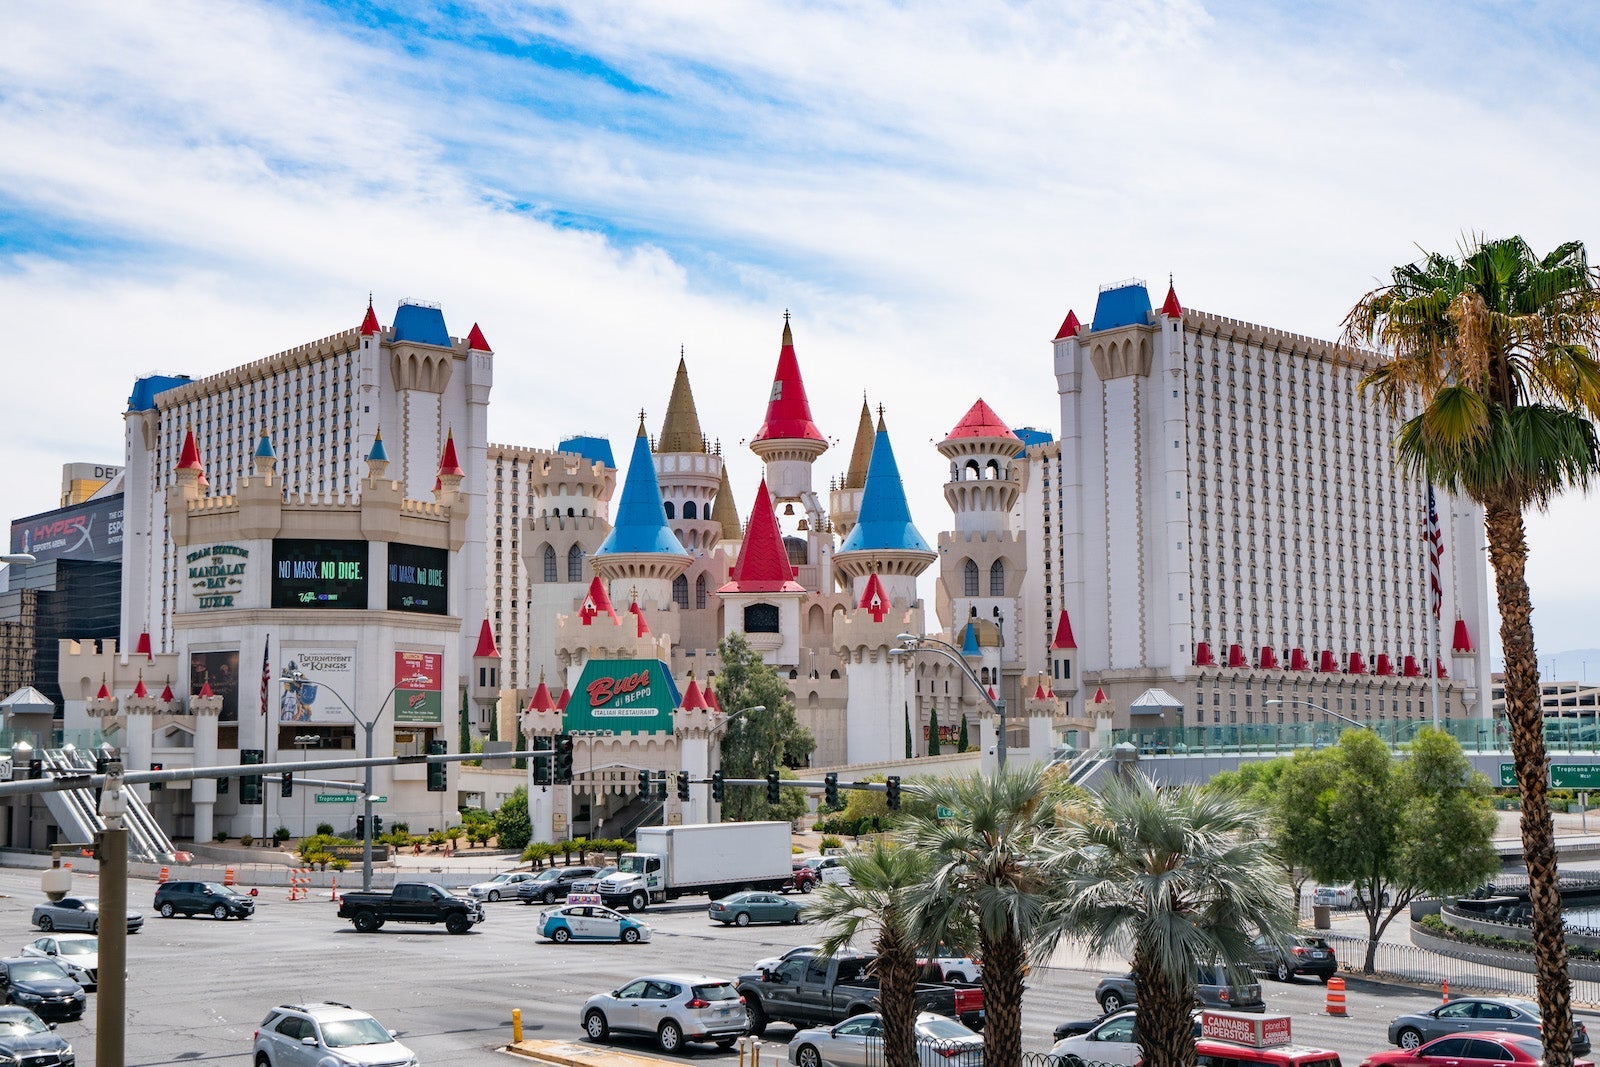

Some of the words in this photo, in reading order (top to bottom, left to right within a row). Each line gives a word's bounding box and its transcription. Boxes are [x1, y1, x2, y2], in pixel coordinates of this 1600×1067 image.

[33, 542, 52, 552] ESPORTS
[52, 538, 66, 550] ARENA
[186, 547, 211, 564] TRAM
[212, 545, 249, 558] STATION
[188, 563, 246, 578] MANDALAY
[278, 560, 290, 579] NO
[293, 561, 320, 579] MASK.
[321, 561, 335, 579] NO
[338, 562, 363, 580] DICE.
[389, 564, 398, 582] NO
[417, 567, 427, 585] NO
[207, 577, 227, 589] BAY
[199, 595, 234, 608] LUXOR
[625, 687, 651, 704] BEPPO
[1208, 1017, 1250, 1032] CANNABIS
[1203, 1025, 1255, 1042] SUPERSTORE
